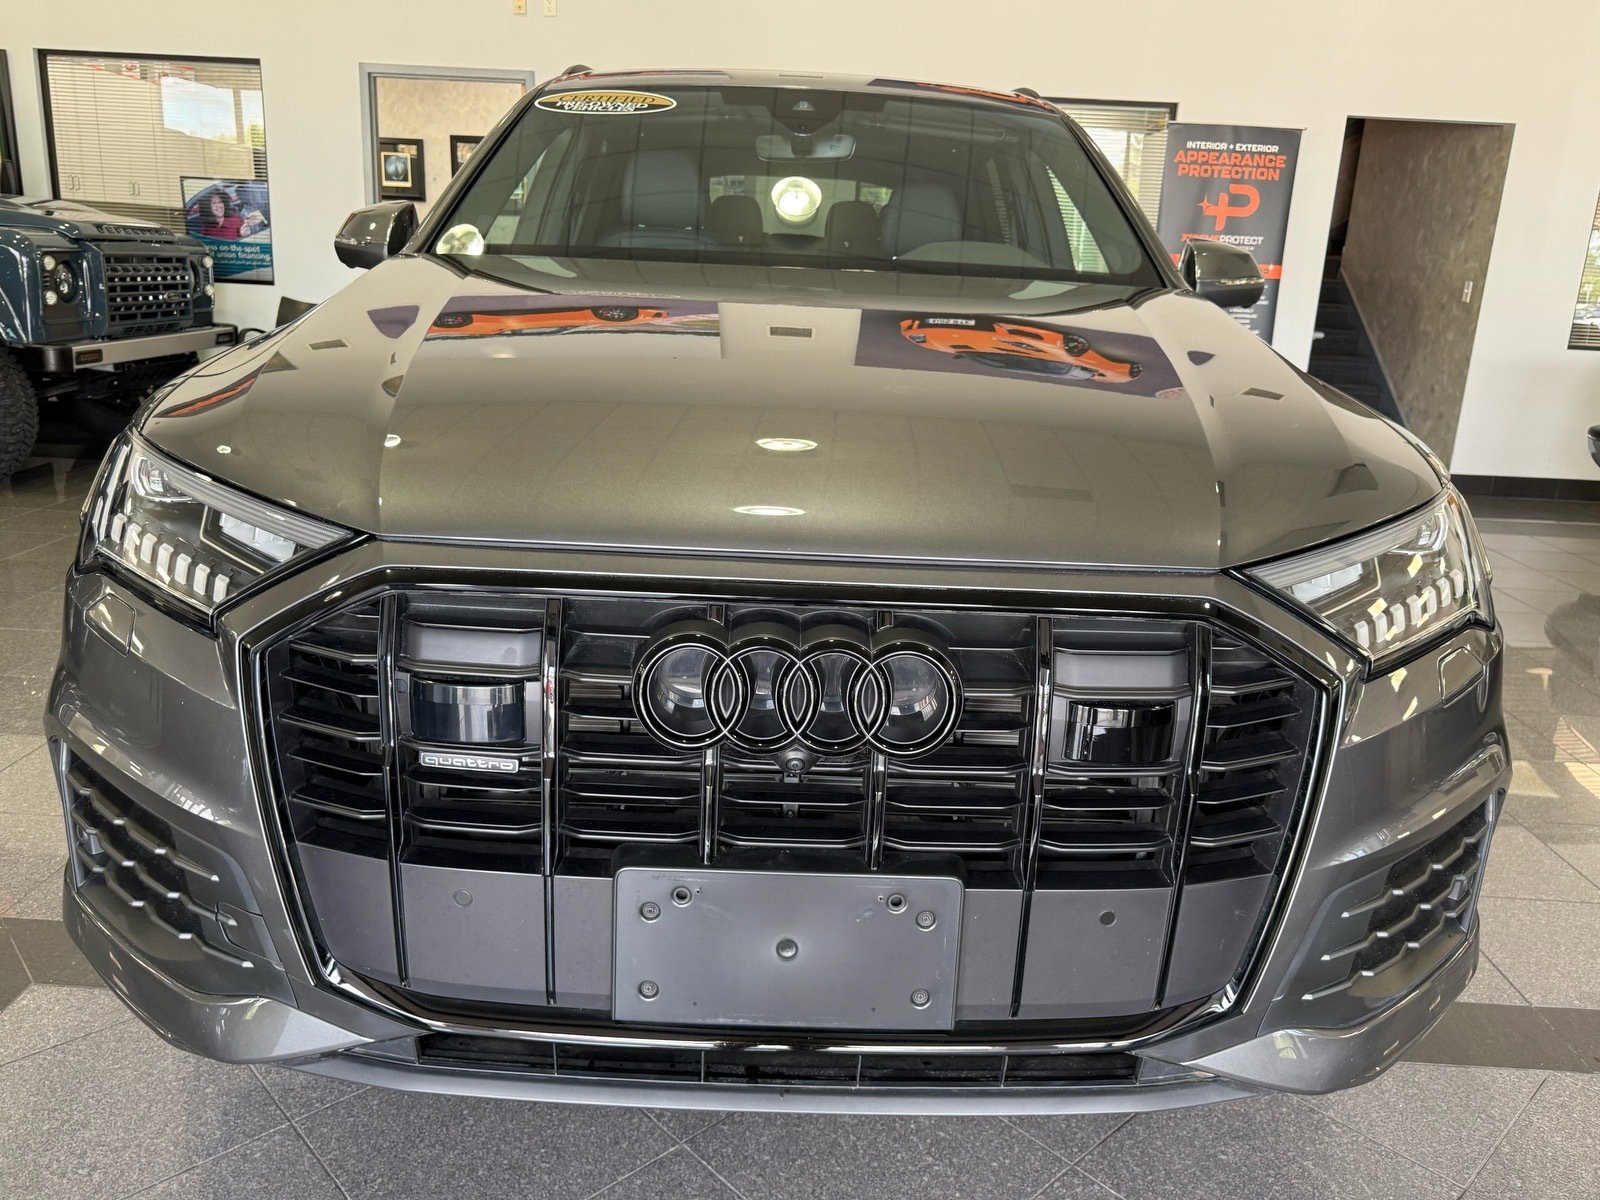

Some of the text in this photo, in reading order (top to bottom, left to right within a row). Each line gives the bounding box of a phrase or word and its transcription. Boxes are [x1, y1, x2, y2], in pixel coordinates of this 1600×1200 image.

[559, 94, 656, 104] CERTIFIED
[564, 103, 636, 112] VEHICLES
[1186, 140, 1228, 151] INTERIOR
[1235, 142, 1279, 153] EXTERIOR
[1174, 151, 1286, 168] APPEARANCE
[1177, 163, 1281, 181] PROTECTION
[425, 756, 514, 770] quattro
